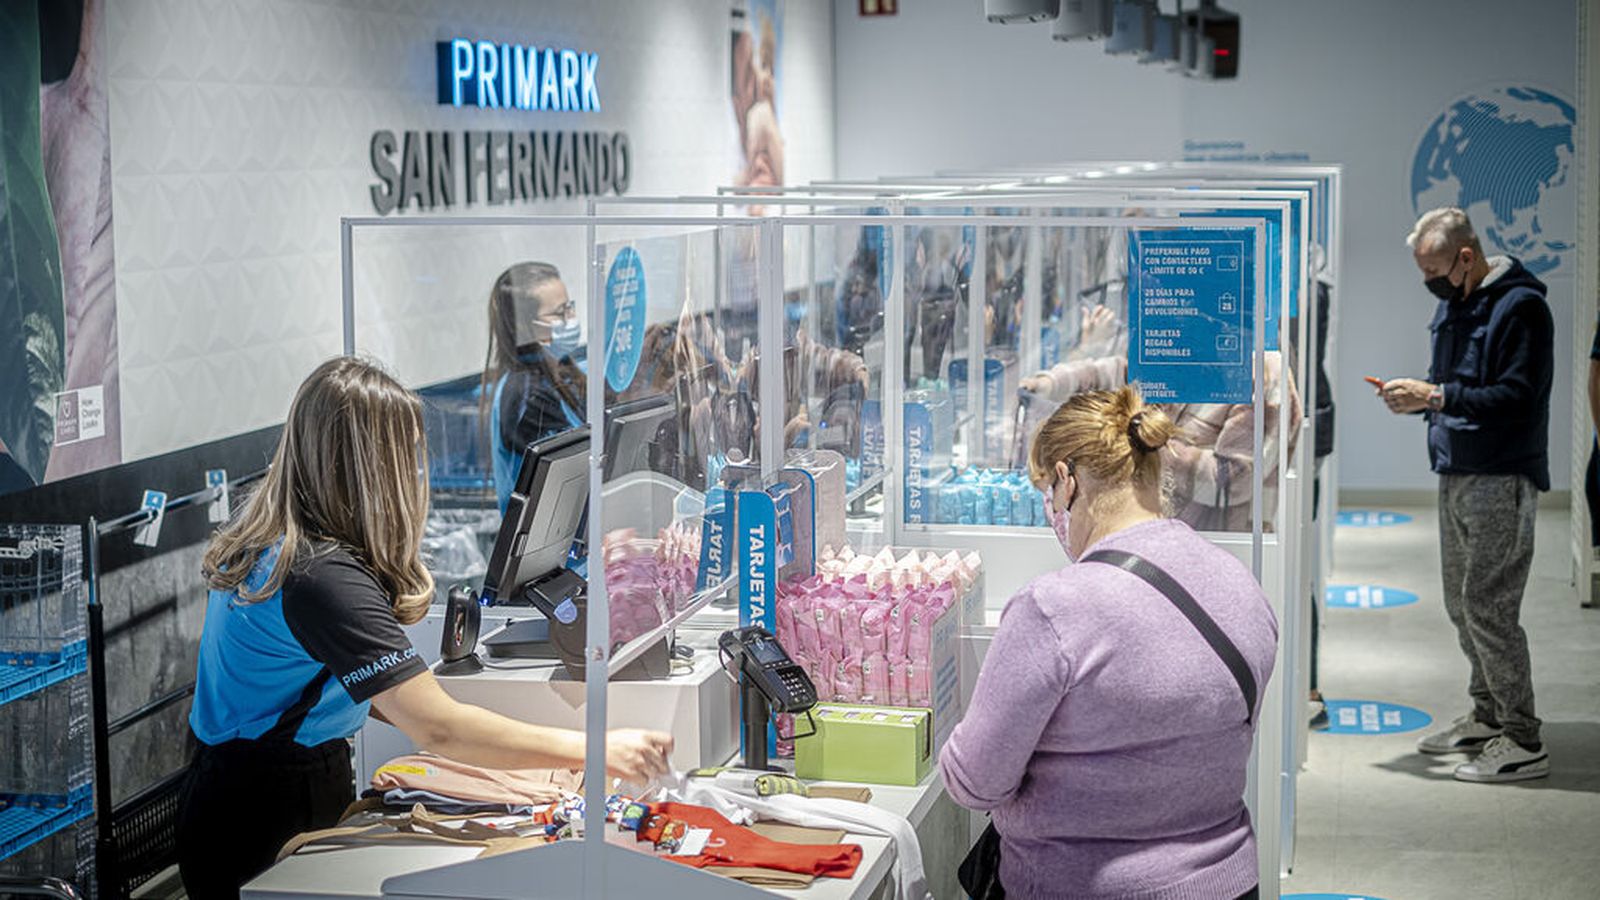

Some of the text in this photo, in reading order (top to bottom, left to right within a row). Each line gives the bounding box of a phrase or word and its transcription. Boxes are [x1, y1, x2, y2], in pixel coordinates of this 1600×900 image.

[451, 38, 600, 112] PRIMARK
[369, 129, 630, 216] SAN FERNANDO
[1190, 247, 1210, 255] PAGO
[1144, 257, 1212, 265] CON CONTACTLESS
[1176, 266, 1186, 274] DE
[1174, 288, 1195, 296] PARA
